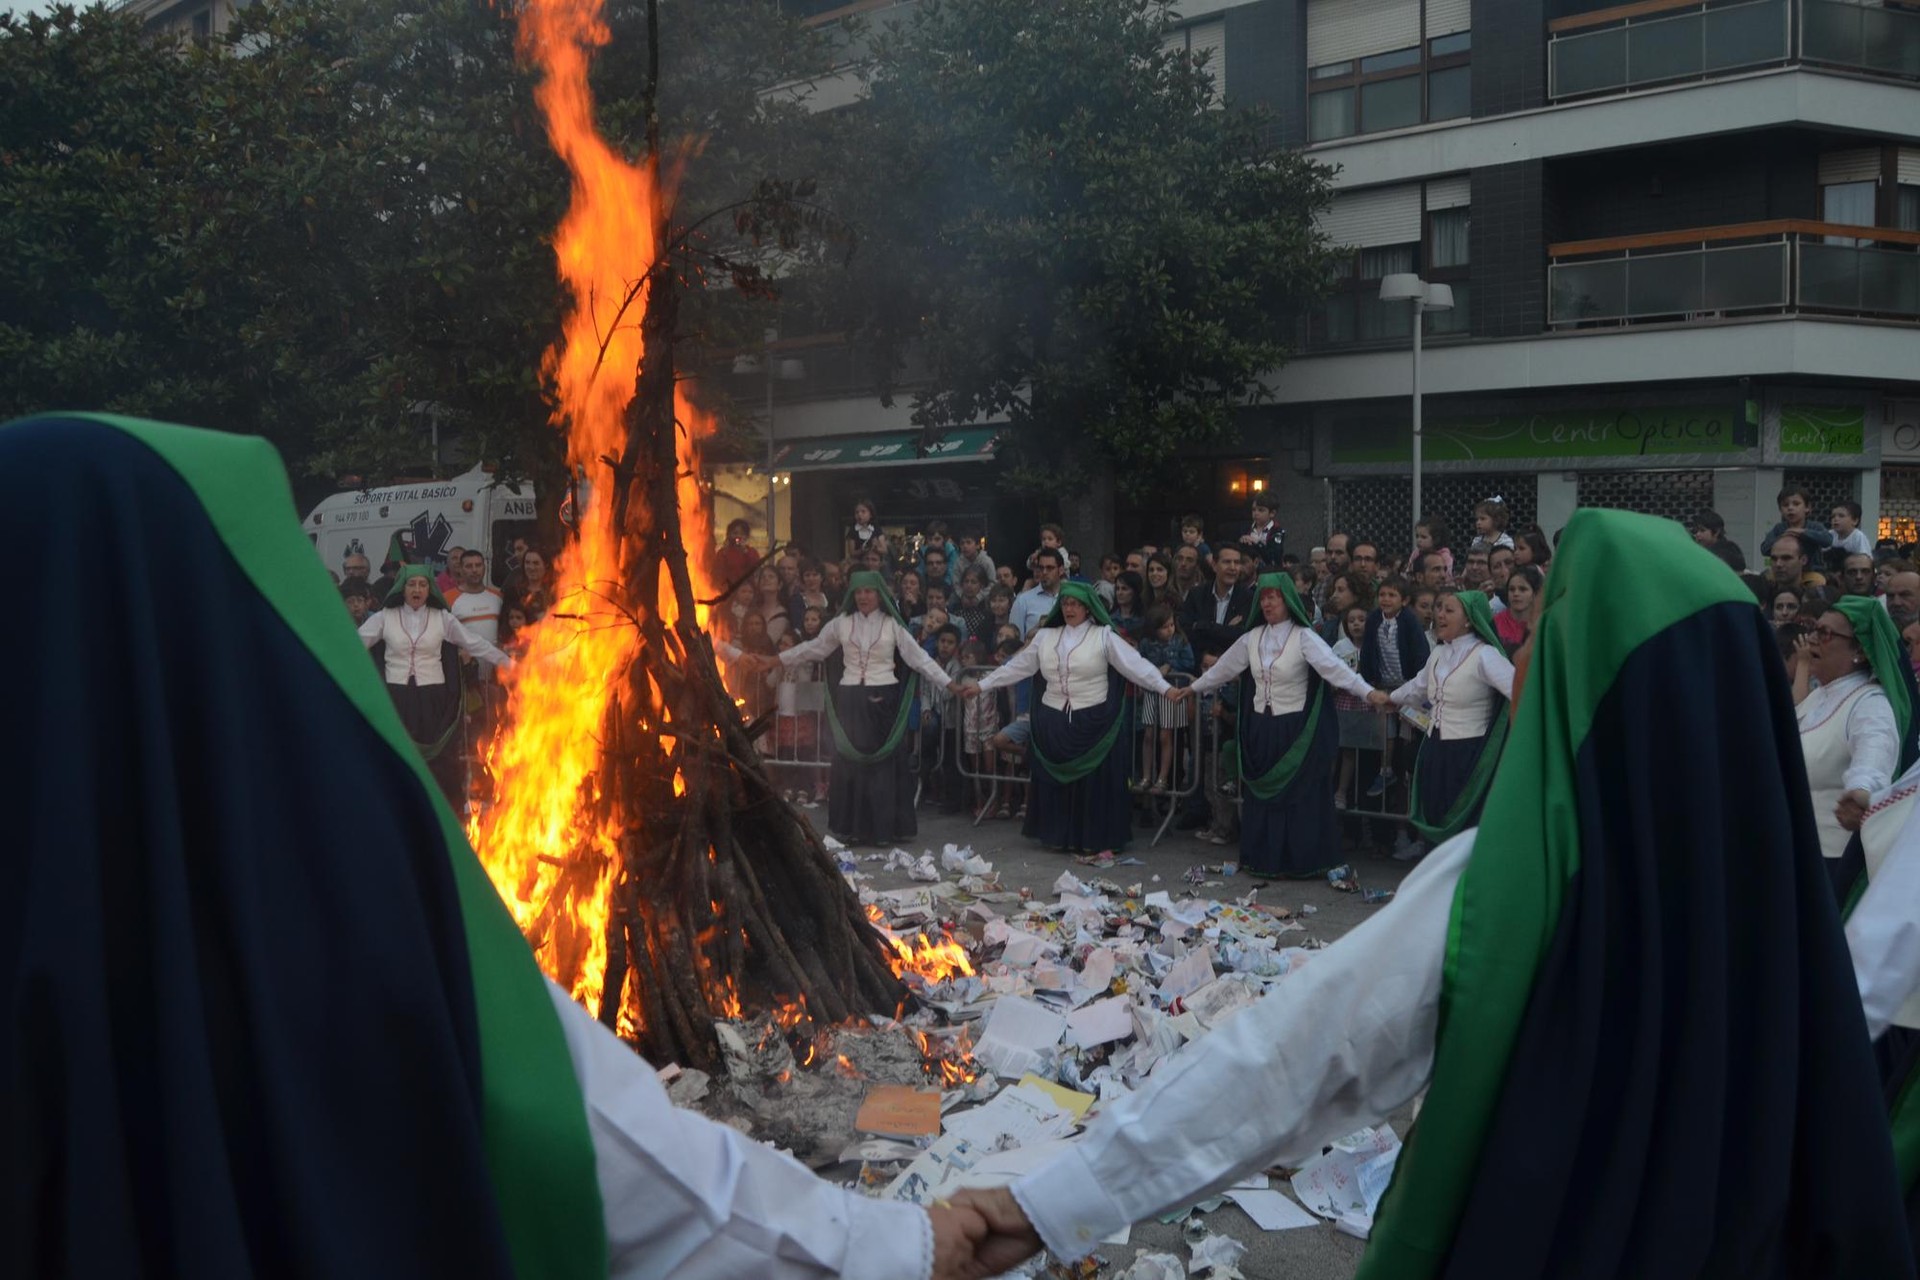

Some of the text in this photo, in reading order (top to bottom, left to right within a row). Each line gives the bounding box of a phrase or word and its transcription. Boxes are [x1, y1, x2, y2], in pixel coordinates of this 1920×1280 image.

[354, 486, 457, 504] SOPORTE VITAL BASICO
